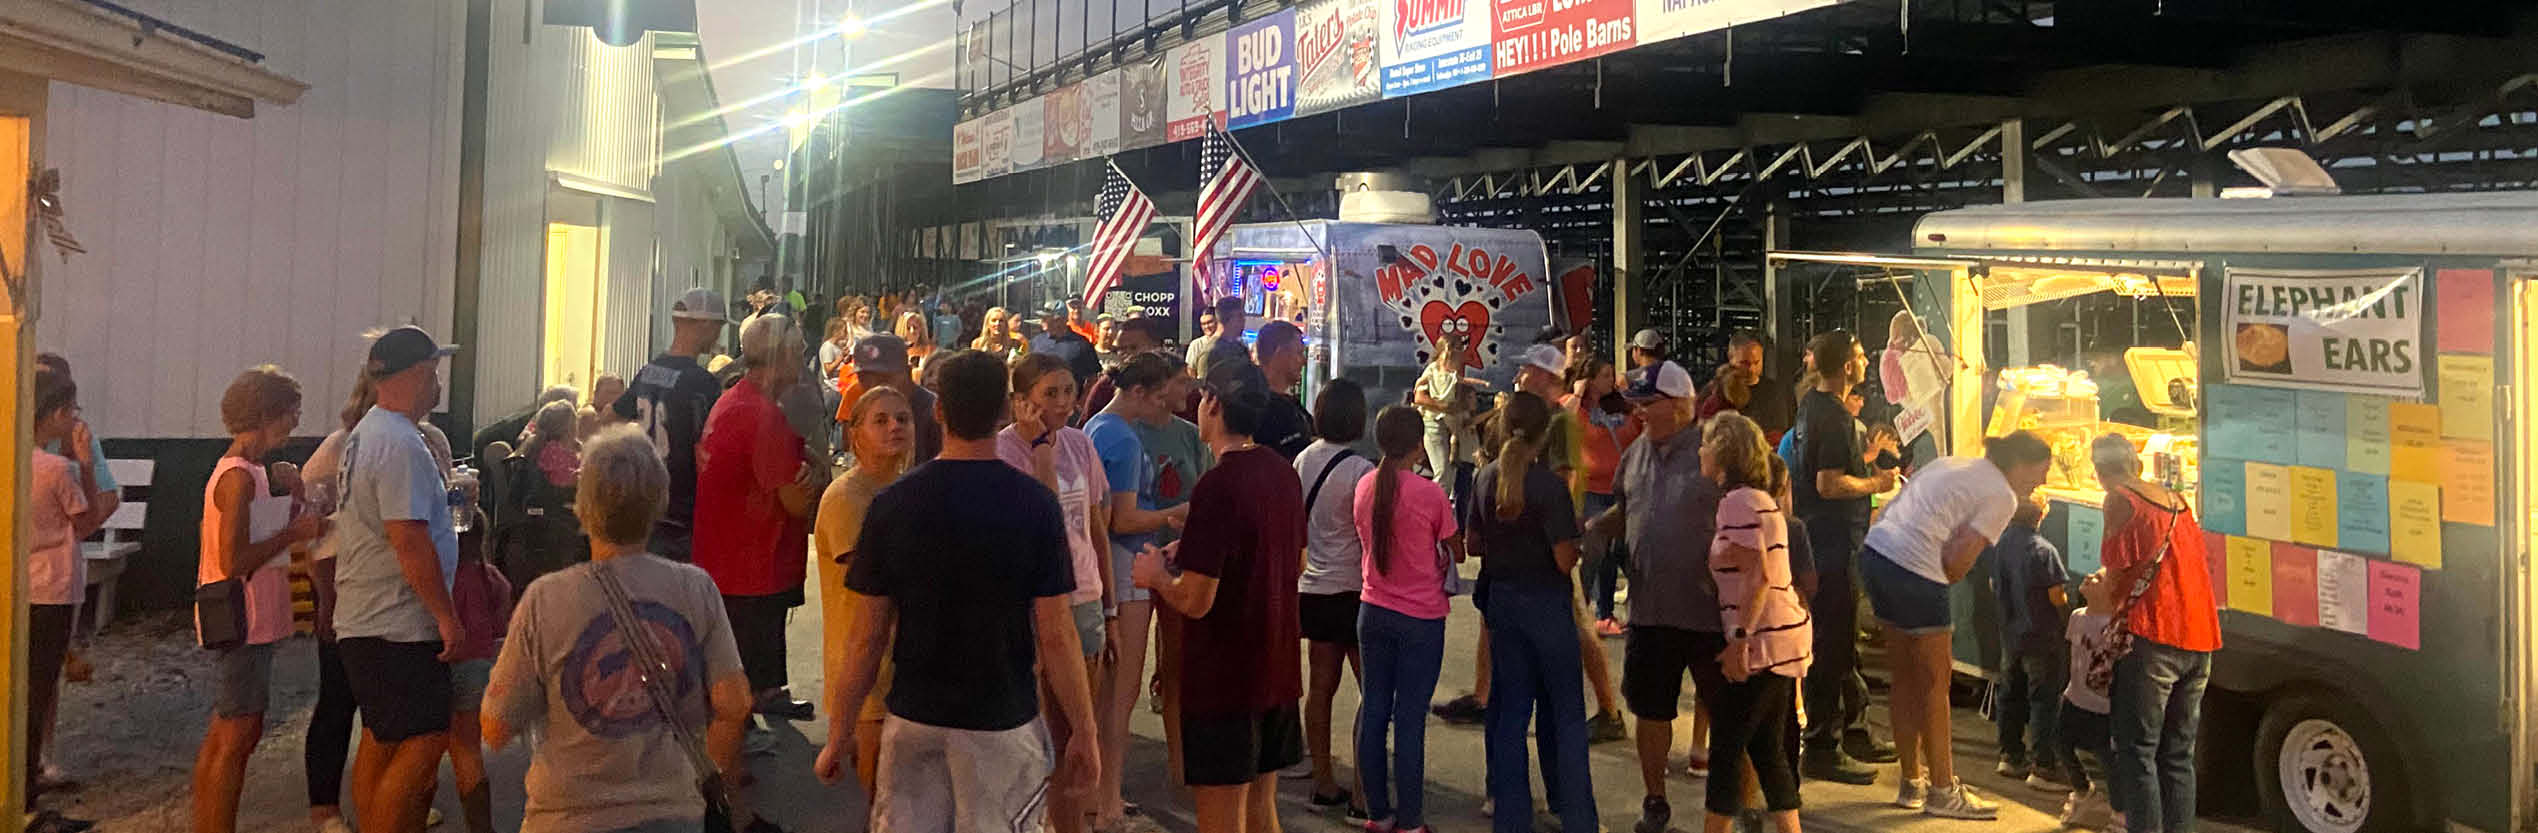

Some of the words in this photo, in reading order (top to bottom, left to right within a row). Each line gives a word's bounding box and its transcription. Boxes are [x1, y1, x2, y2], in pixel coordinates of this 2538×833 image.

[1502, 8, 1527, 23] ATTICA
[1527, 2, 1543, 17] LBR
[1238, 25, 1282, 75] BUD
[1550, 23, 1583, 57] Pole
[1586, 16, 1633, 48] Barns
[1230, 65, 1292, 118] LIGHT
[1376, 245, 1438, 303] MAD
[1447, 243, 1536, 301] LOVE
[1134, 292, 1175, 303] CHOPP
[2323, 337, 2412, 374] EARS
